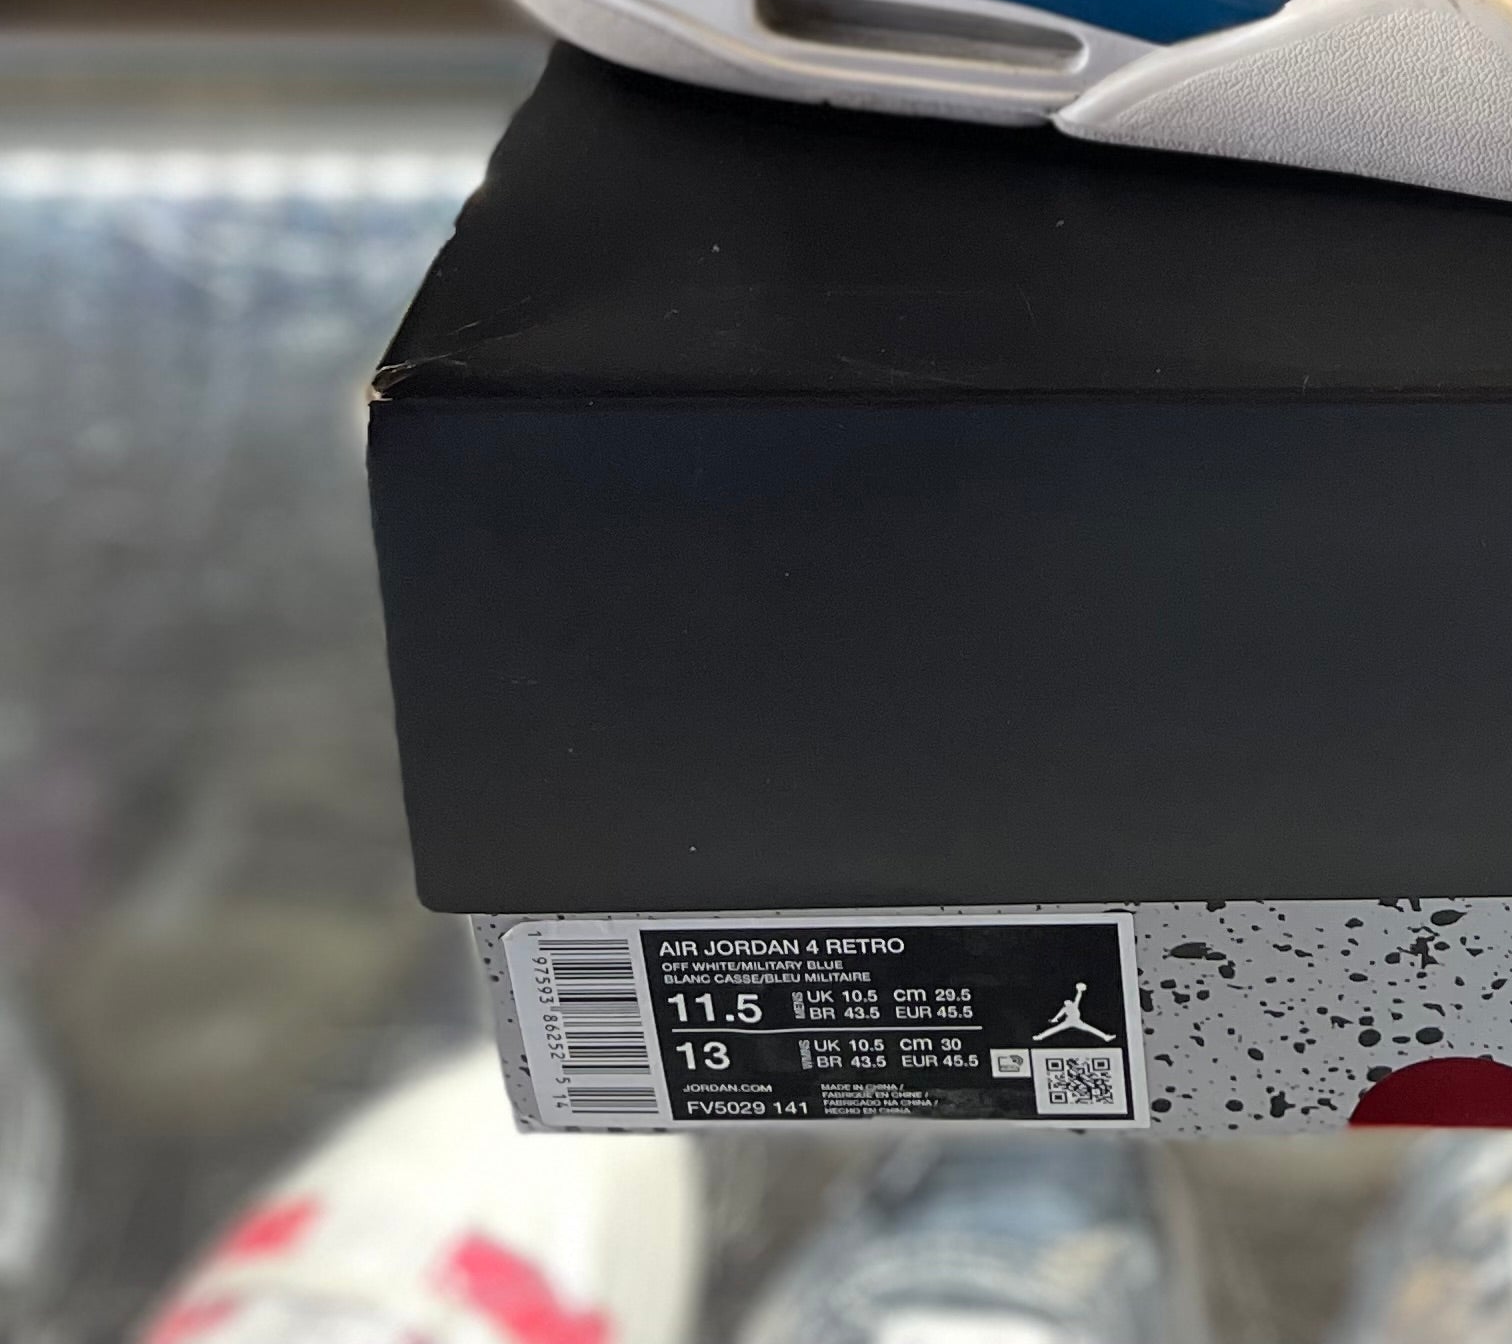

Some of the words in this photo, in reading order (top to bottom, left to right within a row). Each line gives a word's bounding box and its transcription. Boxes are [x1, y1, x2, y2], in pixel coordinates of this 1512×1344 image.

[659, 941, 698, 957] AIR
[703, 939, 799, 956] JORDAN
[805, 939, 819, 954] 4
[826, 937, 905, 954] RETRO
[662, 963, 688, 971] OFF
[693, 961, 802, 971] WHITE/MILITARY
[807, 960, 843, 970] BLUE
[664, 975, 710, 984] BLANC
[714, 973, 800, 984] CASSE/BLEU
[804, 972, 871, 982] MILITAIRE
[807, 990, 834, 1003] UK
[842, 989, 878, 1002] 10.5
[893, 988, 927, 1001] cm
[935, 988, 972, 1001] 29.5
[532, 957, 554, 1005] 97593
[543, 1014, 566, 1060] 86252
[668, 993, 763, 1023] 11.5
[809, 1007, 835, 1019] BR
[844, 1007, 880, 1019] 43.5
[895, 1006, 932, 1018] EUR
[937, 1005, 973, 1018] 45.5
[814, 1039, 841, 1051] UK
[849, 1039, 885, 1051] 10.5
[900, 1038, 933, 1051] cm
[941, 1038, 962, 1050] 30
[676, 1041, 731, 1070] 13
[817, 1056, 842, 1068] BR
[851, 1055, 887, 1068] 43.5
[902, 1055, 938, 1067] EUR
[943, 1055, 979, 1067] 45.5
[683, 1084, 772, 1093] JORDAN.COM
[821, 1083, 851, 1091] MADE
[852, 1083, 864, 1091] IN
[687, 1101, 765, 1114] FV5029
[773, 1101, 808, 1114] 141
